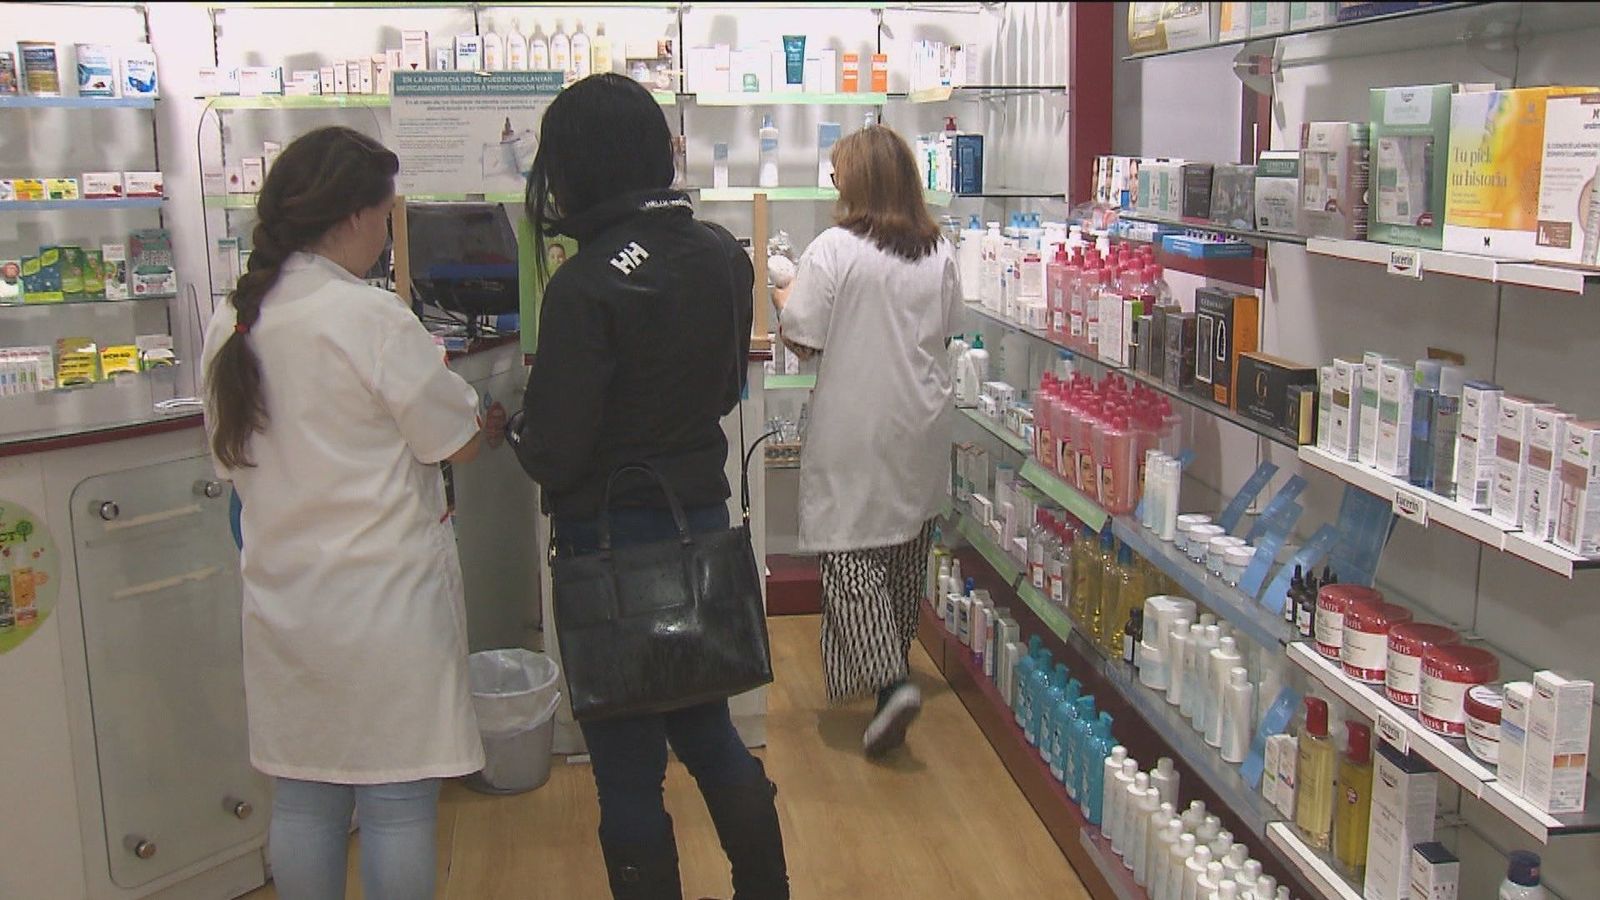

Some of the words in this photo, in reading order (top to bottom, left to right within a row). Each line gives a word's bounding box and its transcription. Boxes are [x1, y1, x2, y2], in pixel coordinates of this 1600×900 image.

[1454, 147, 1467, 163] Tu
[1452, 172, 1465, 187] tu
[1465, 169, 1507, 188] historia
[609, 241, 650, 275] HH
